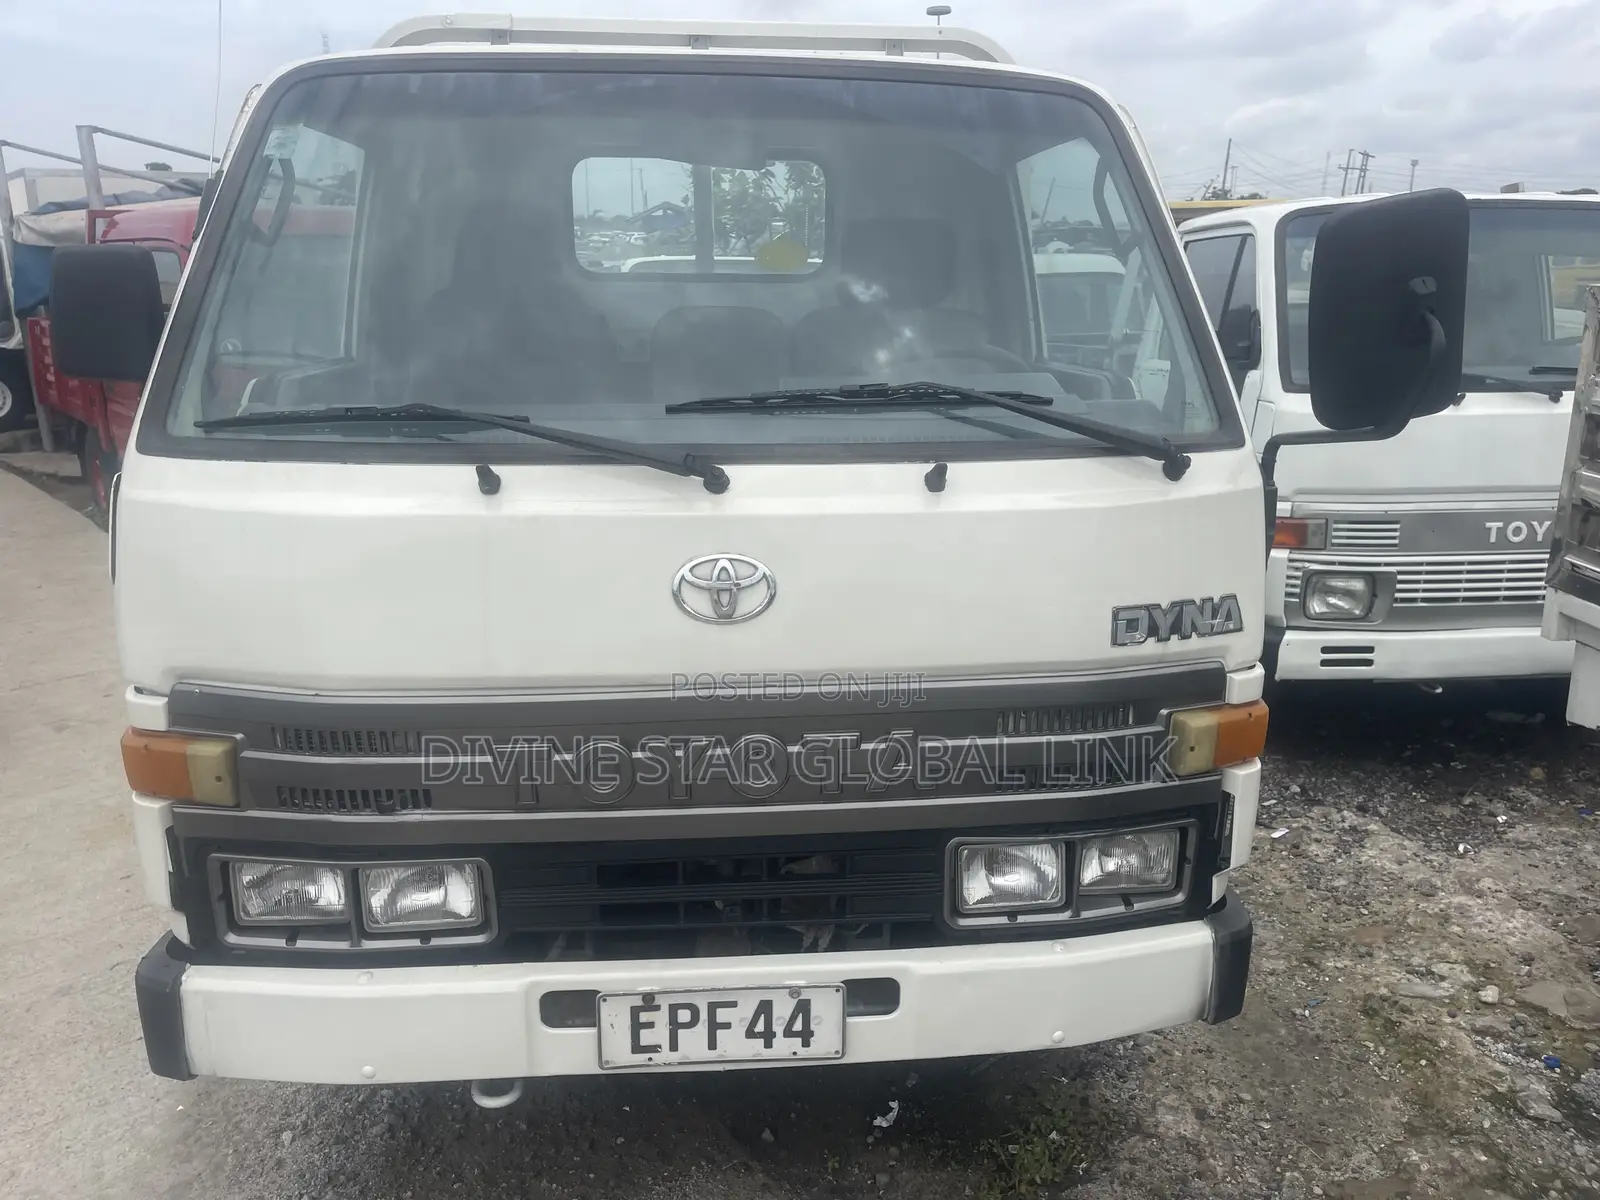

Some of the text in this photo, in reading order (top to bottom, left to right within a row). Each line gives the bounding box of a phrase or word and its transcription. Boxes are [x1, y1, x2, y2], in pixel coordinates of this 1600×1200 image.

[1110, 593, 1244, 646] DYNA
[494, 730, 936, 804] TOYOTA
[630, 999, 814, 1054] EPF44
